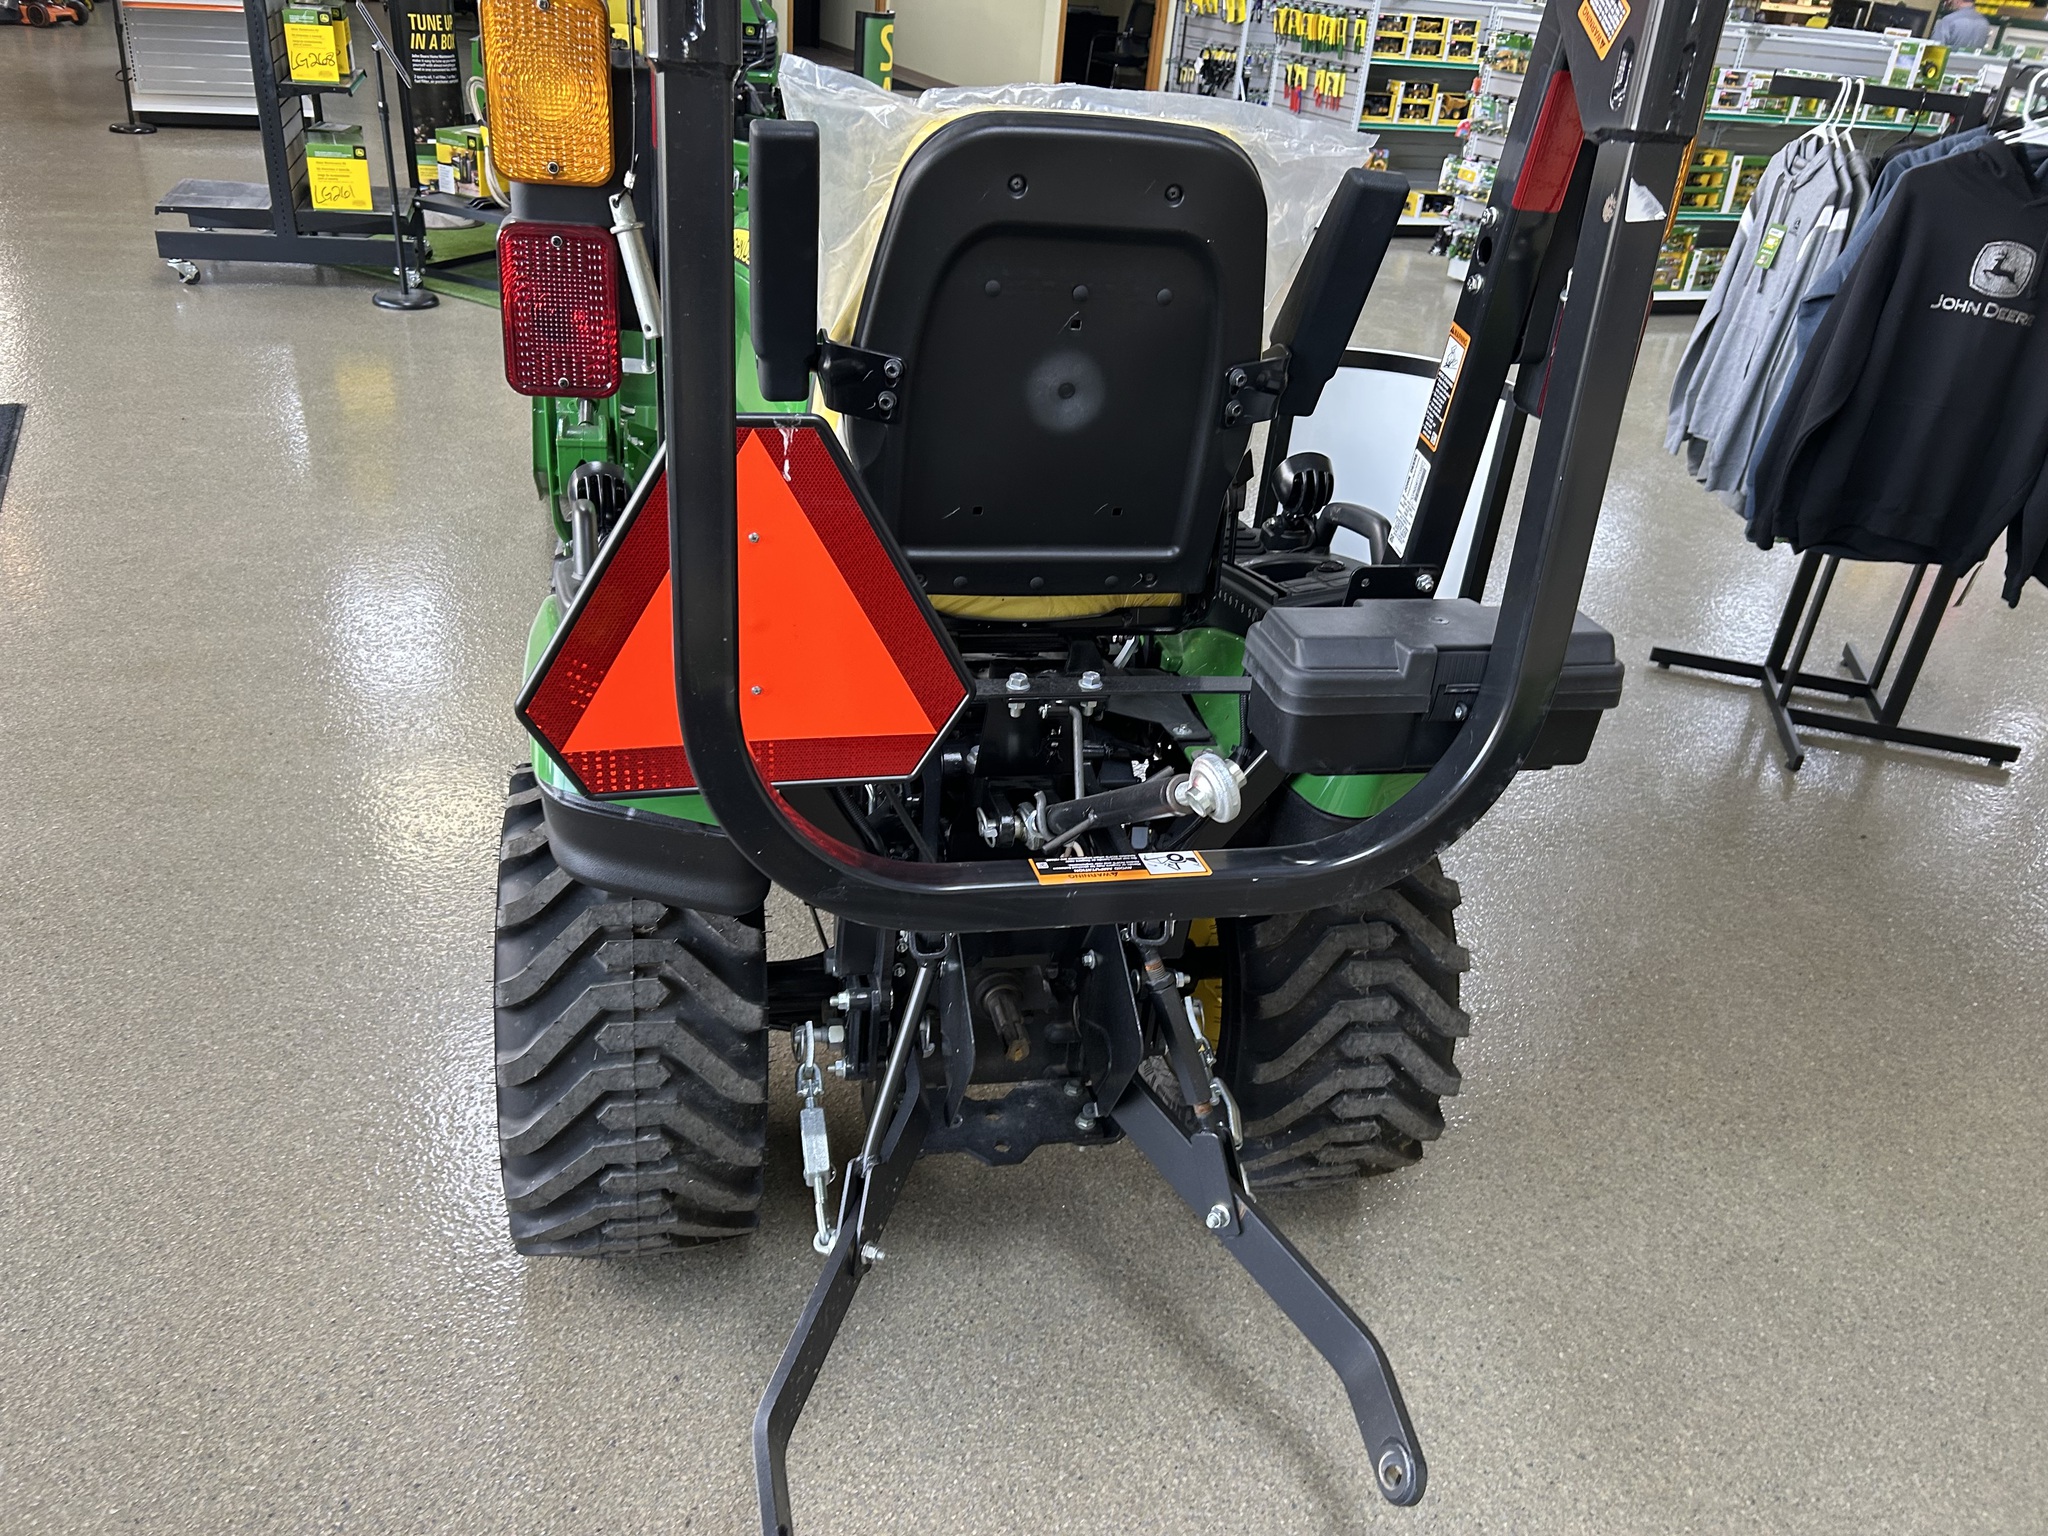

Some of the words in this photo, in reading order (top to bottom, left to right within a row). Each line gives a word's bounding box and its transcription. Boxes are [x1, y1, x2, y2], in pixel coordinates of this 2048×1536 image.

[407, 13, 443, 31] TUNE
[444, 14, 453, 31] UP
[1582, 6, 1602, 44] WARNING
[410, 33, 426, 50] IN
[429, 33, 438, 50] A
[290, 50, 336, 70] LG268
[1930, 293, 1982, 316] JOHN
